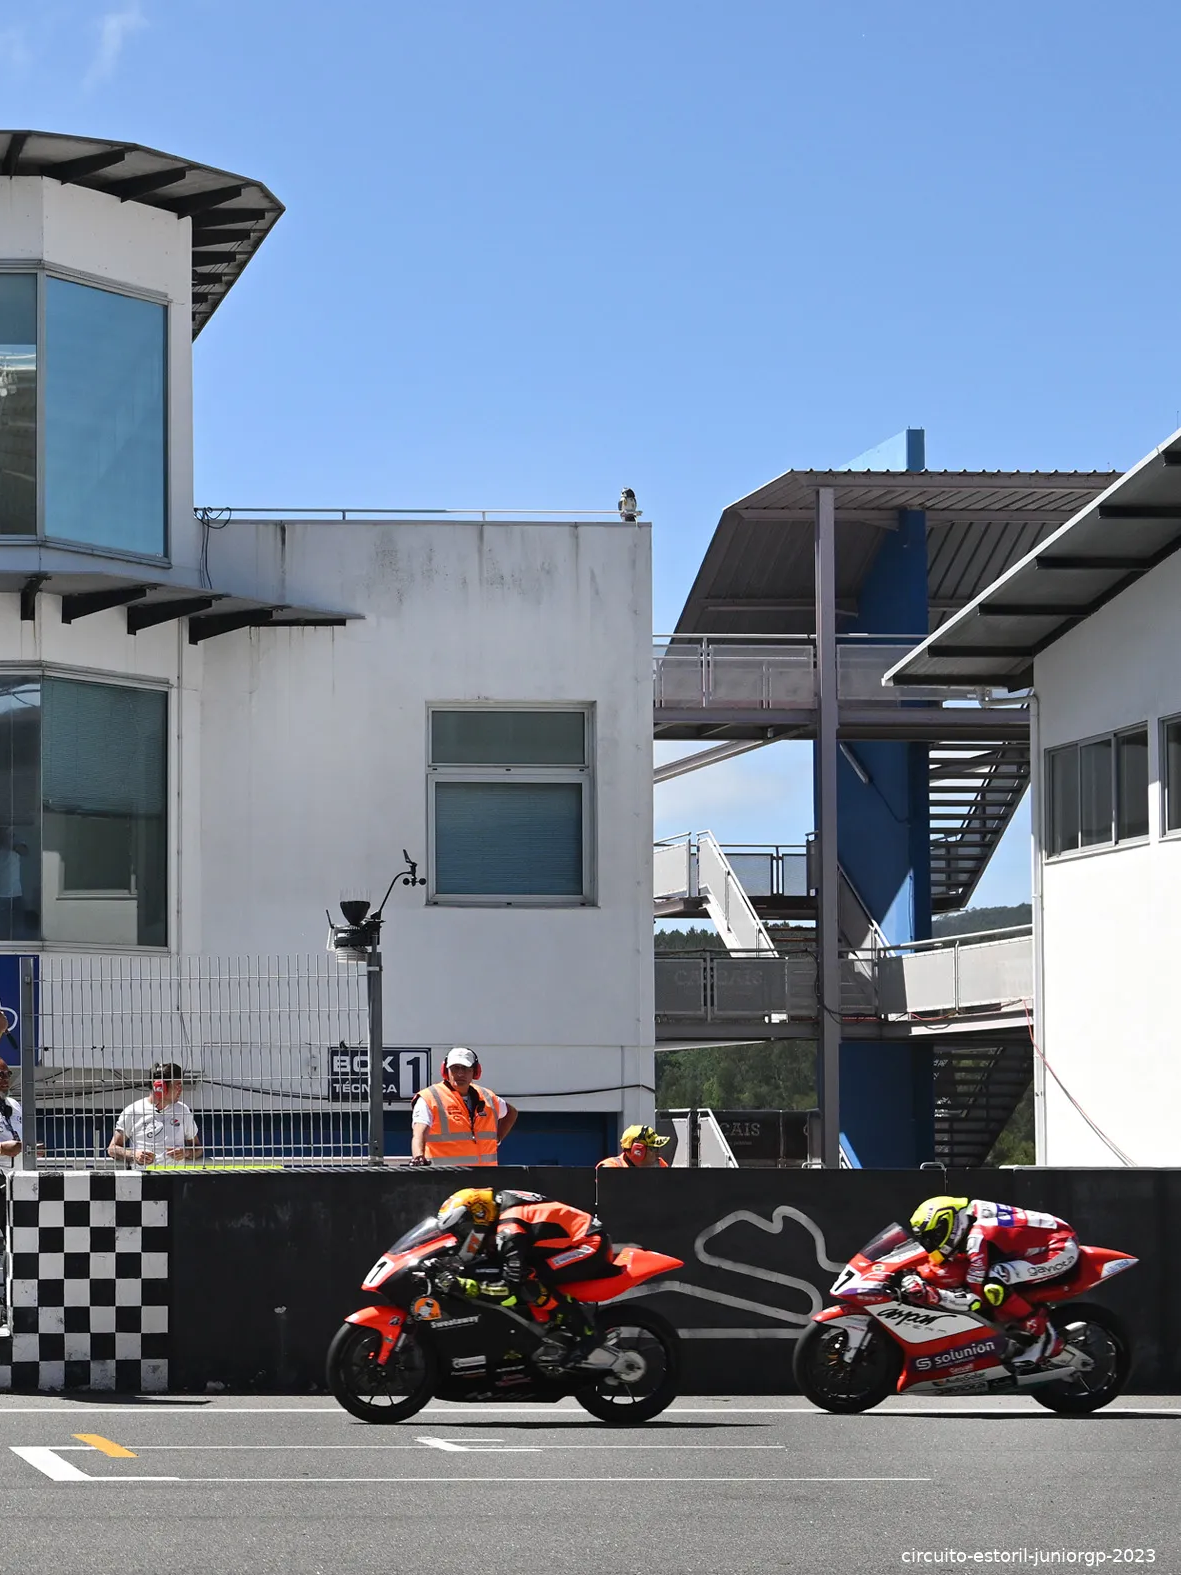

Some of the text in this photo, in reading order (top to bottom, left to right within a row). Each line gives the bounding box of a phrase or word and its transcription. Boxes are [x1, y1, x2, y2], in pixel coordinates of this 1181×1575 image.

[406, 1056, 421, 1094] 1
[333, 1081, 398, 1093] TÉCNCA
[834, 1269, 856, 1292] 7
